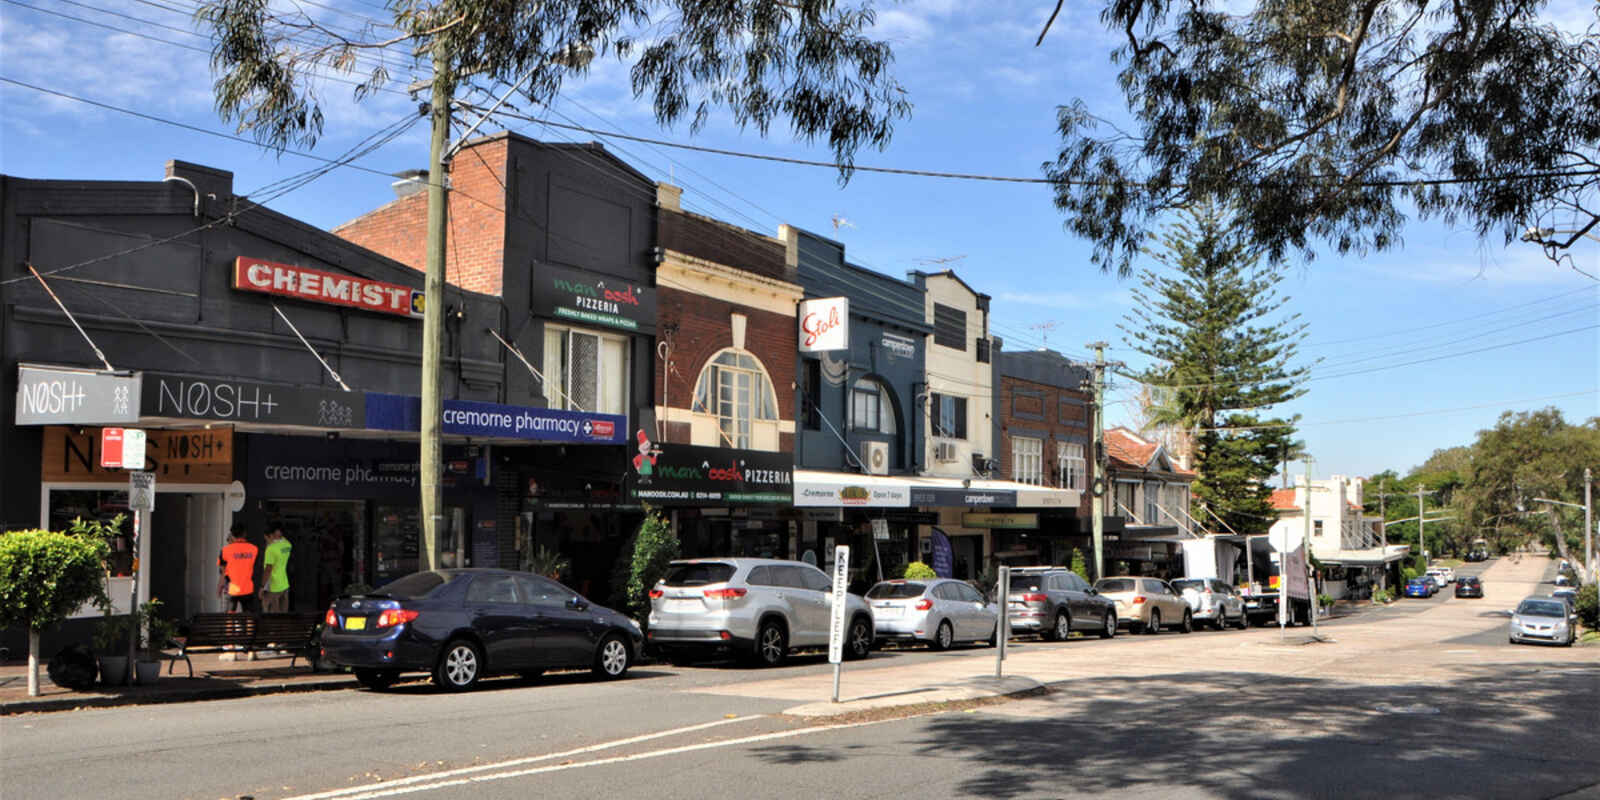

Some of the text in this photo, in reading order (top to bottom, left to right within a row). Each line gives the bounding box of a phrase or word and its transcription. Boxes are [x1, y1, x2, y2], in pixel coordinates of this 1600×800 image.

[247, 263, 407, 310] CHEMIST
[576, 296, 619, 314] PIZZERIA
[802, 306, 840, 346] Stoli
[443, 408, 512, 428] cremorne
[515, 411, 580, 437] pharmacy
[264, 463, 341, 481] cremorne
[744, 469, 791, 485] PIZZERIA
